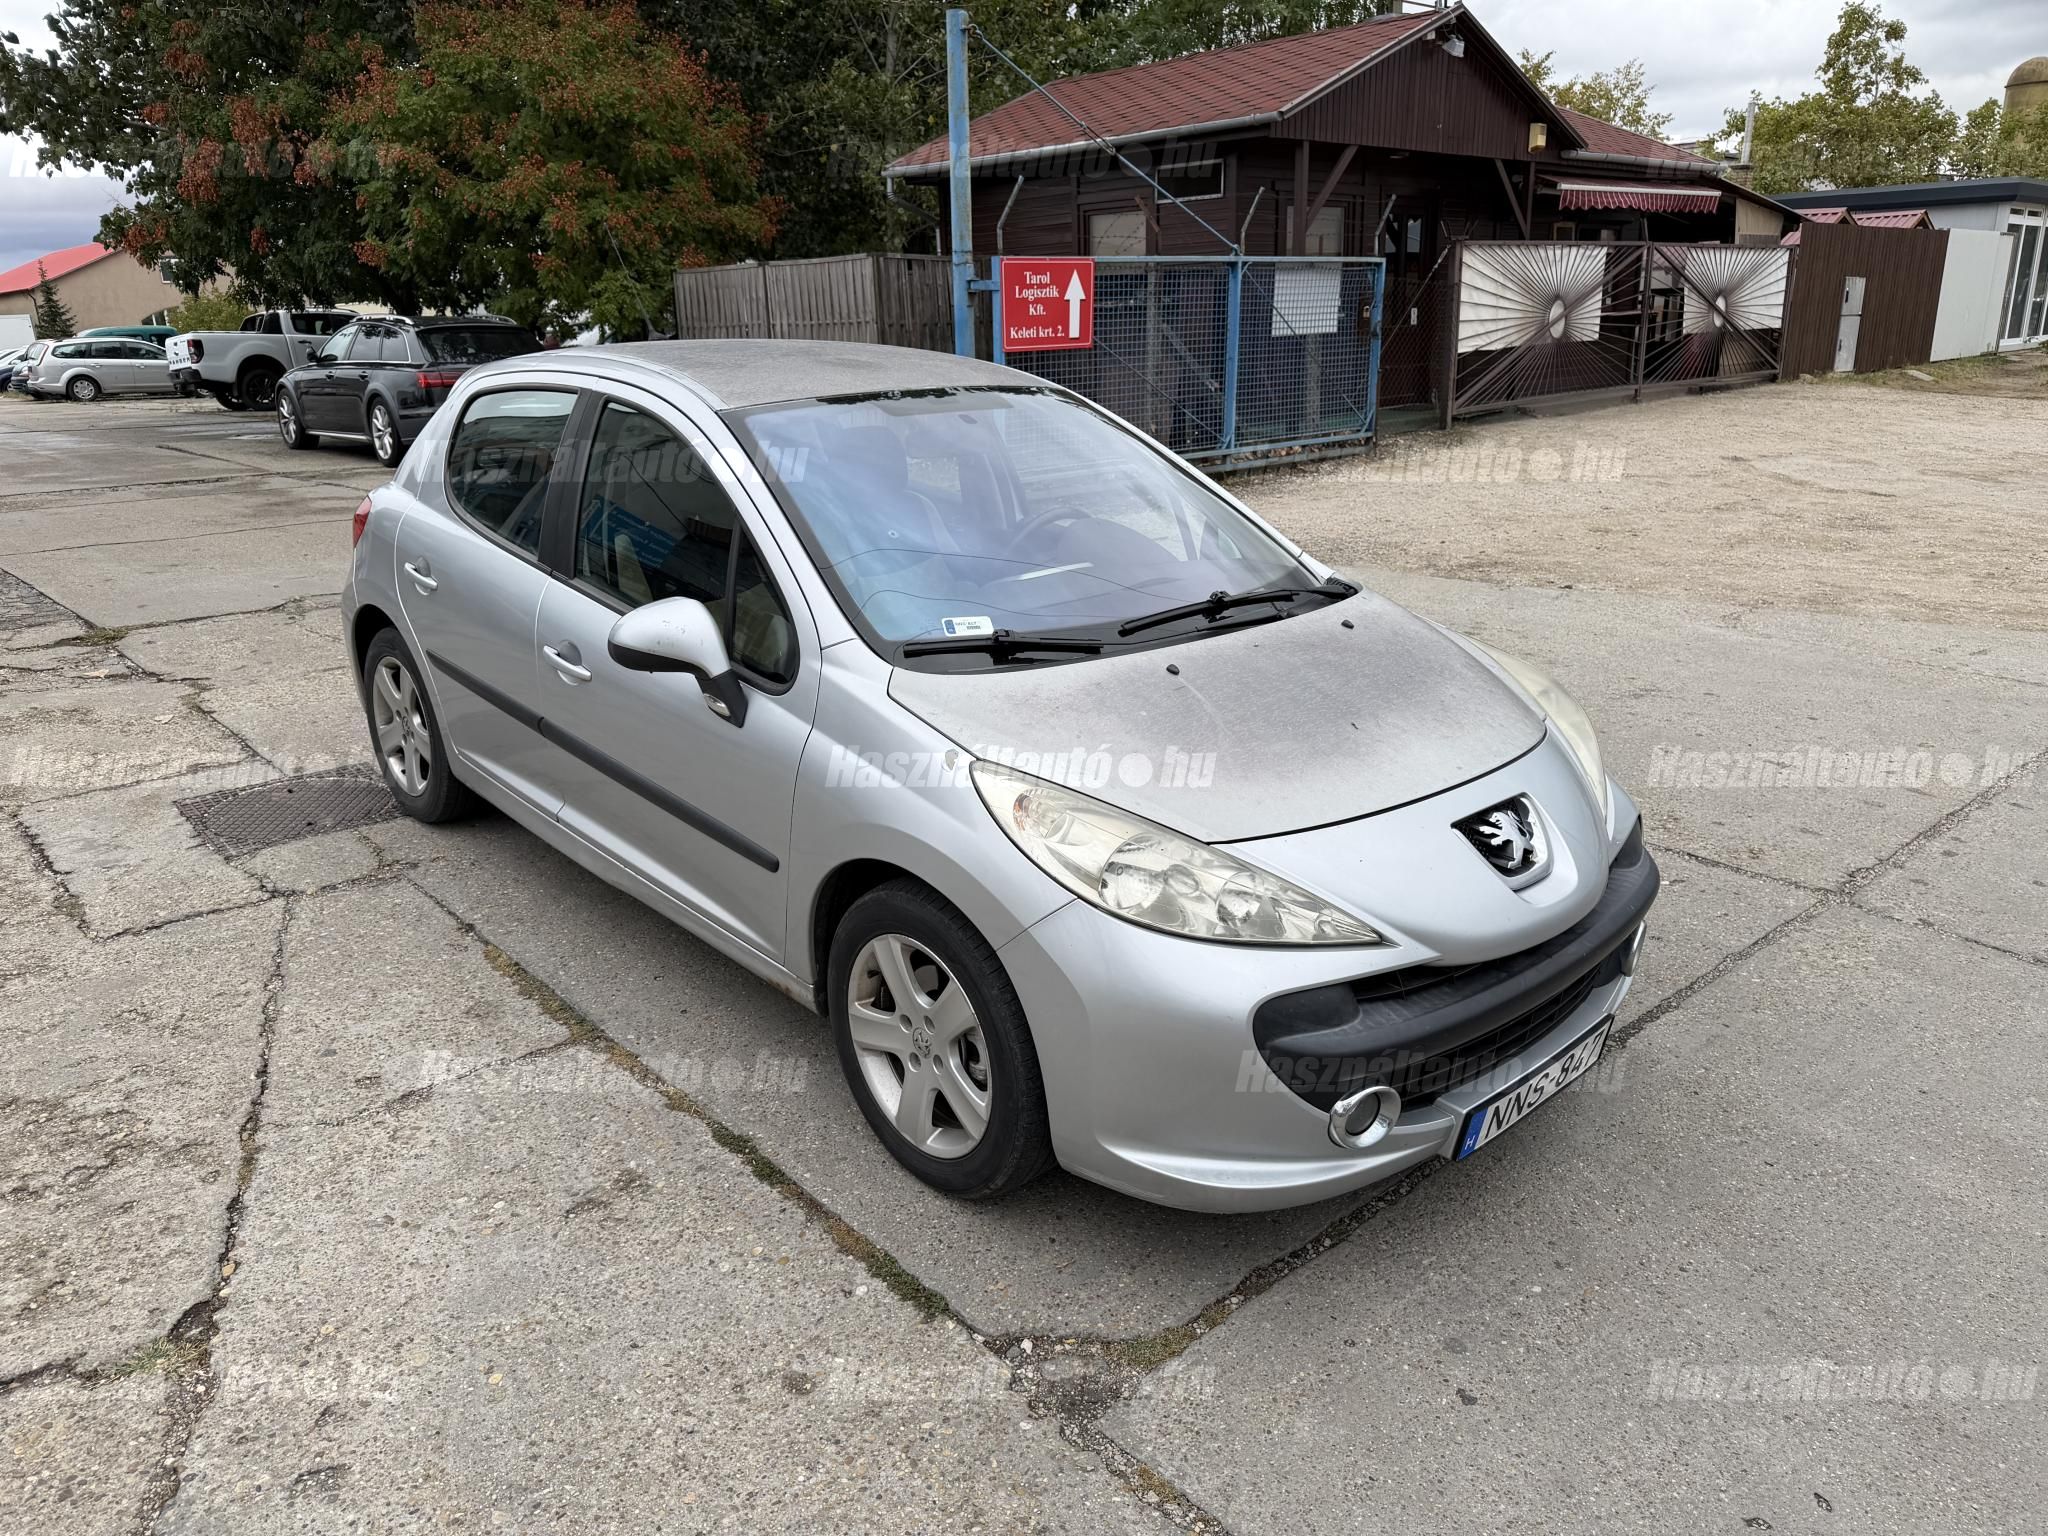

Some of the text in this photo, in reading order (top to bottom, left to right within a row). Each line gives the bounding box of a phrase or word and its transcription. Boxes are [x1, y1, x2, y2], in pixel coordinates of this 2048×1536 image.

[1024, 271, 1050, 284] Tarol
[1015, 285, 1060, 301] Logisztik
[1029, 303, 1046, 316] Kft.
[1010, 325, 1065, 339] Keleti krt. 2.
[1484, 1028, 1606, 1140] NNS-847
[1464, 1136, 1475, 1150] H
